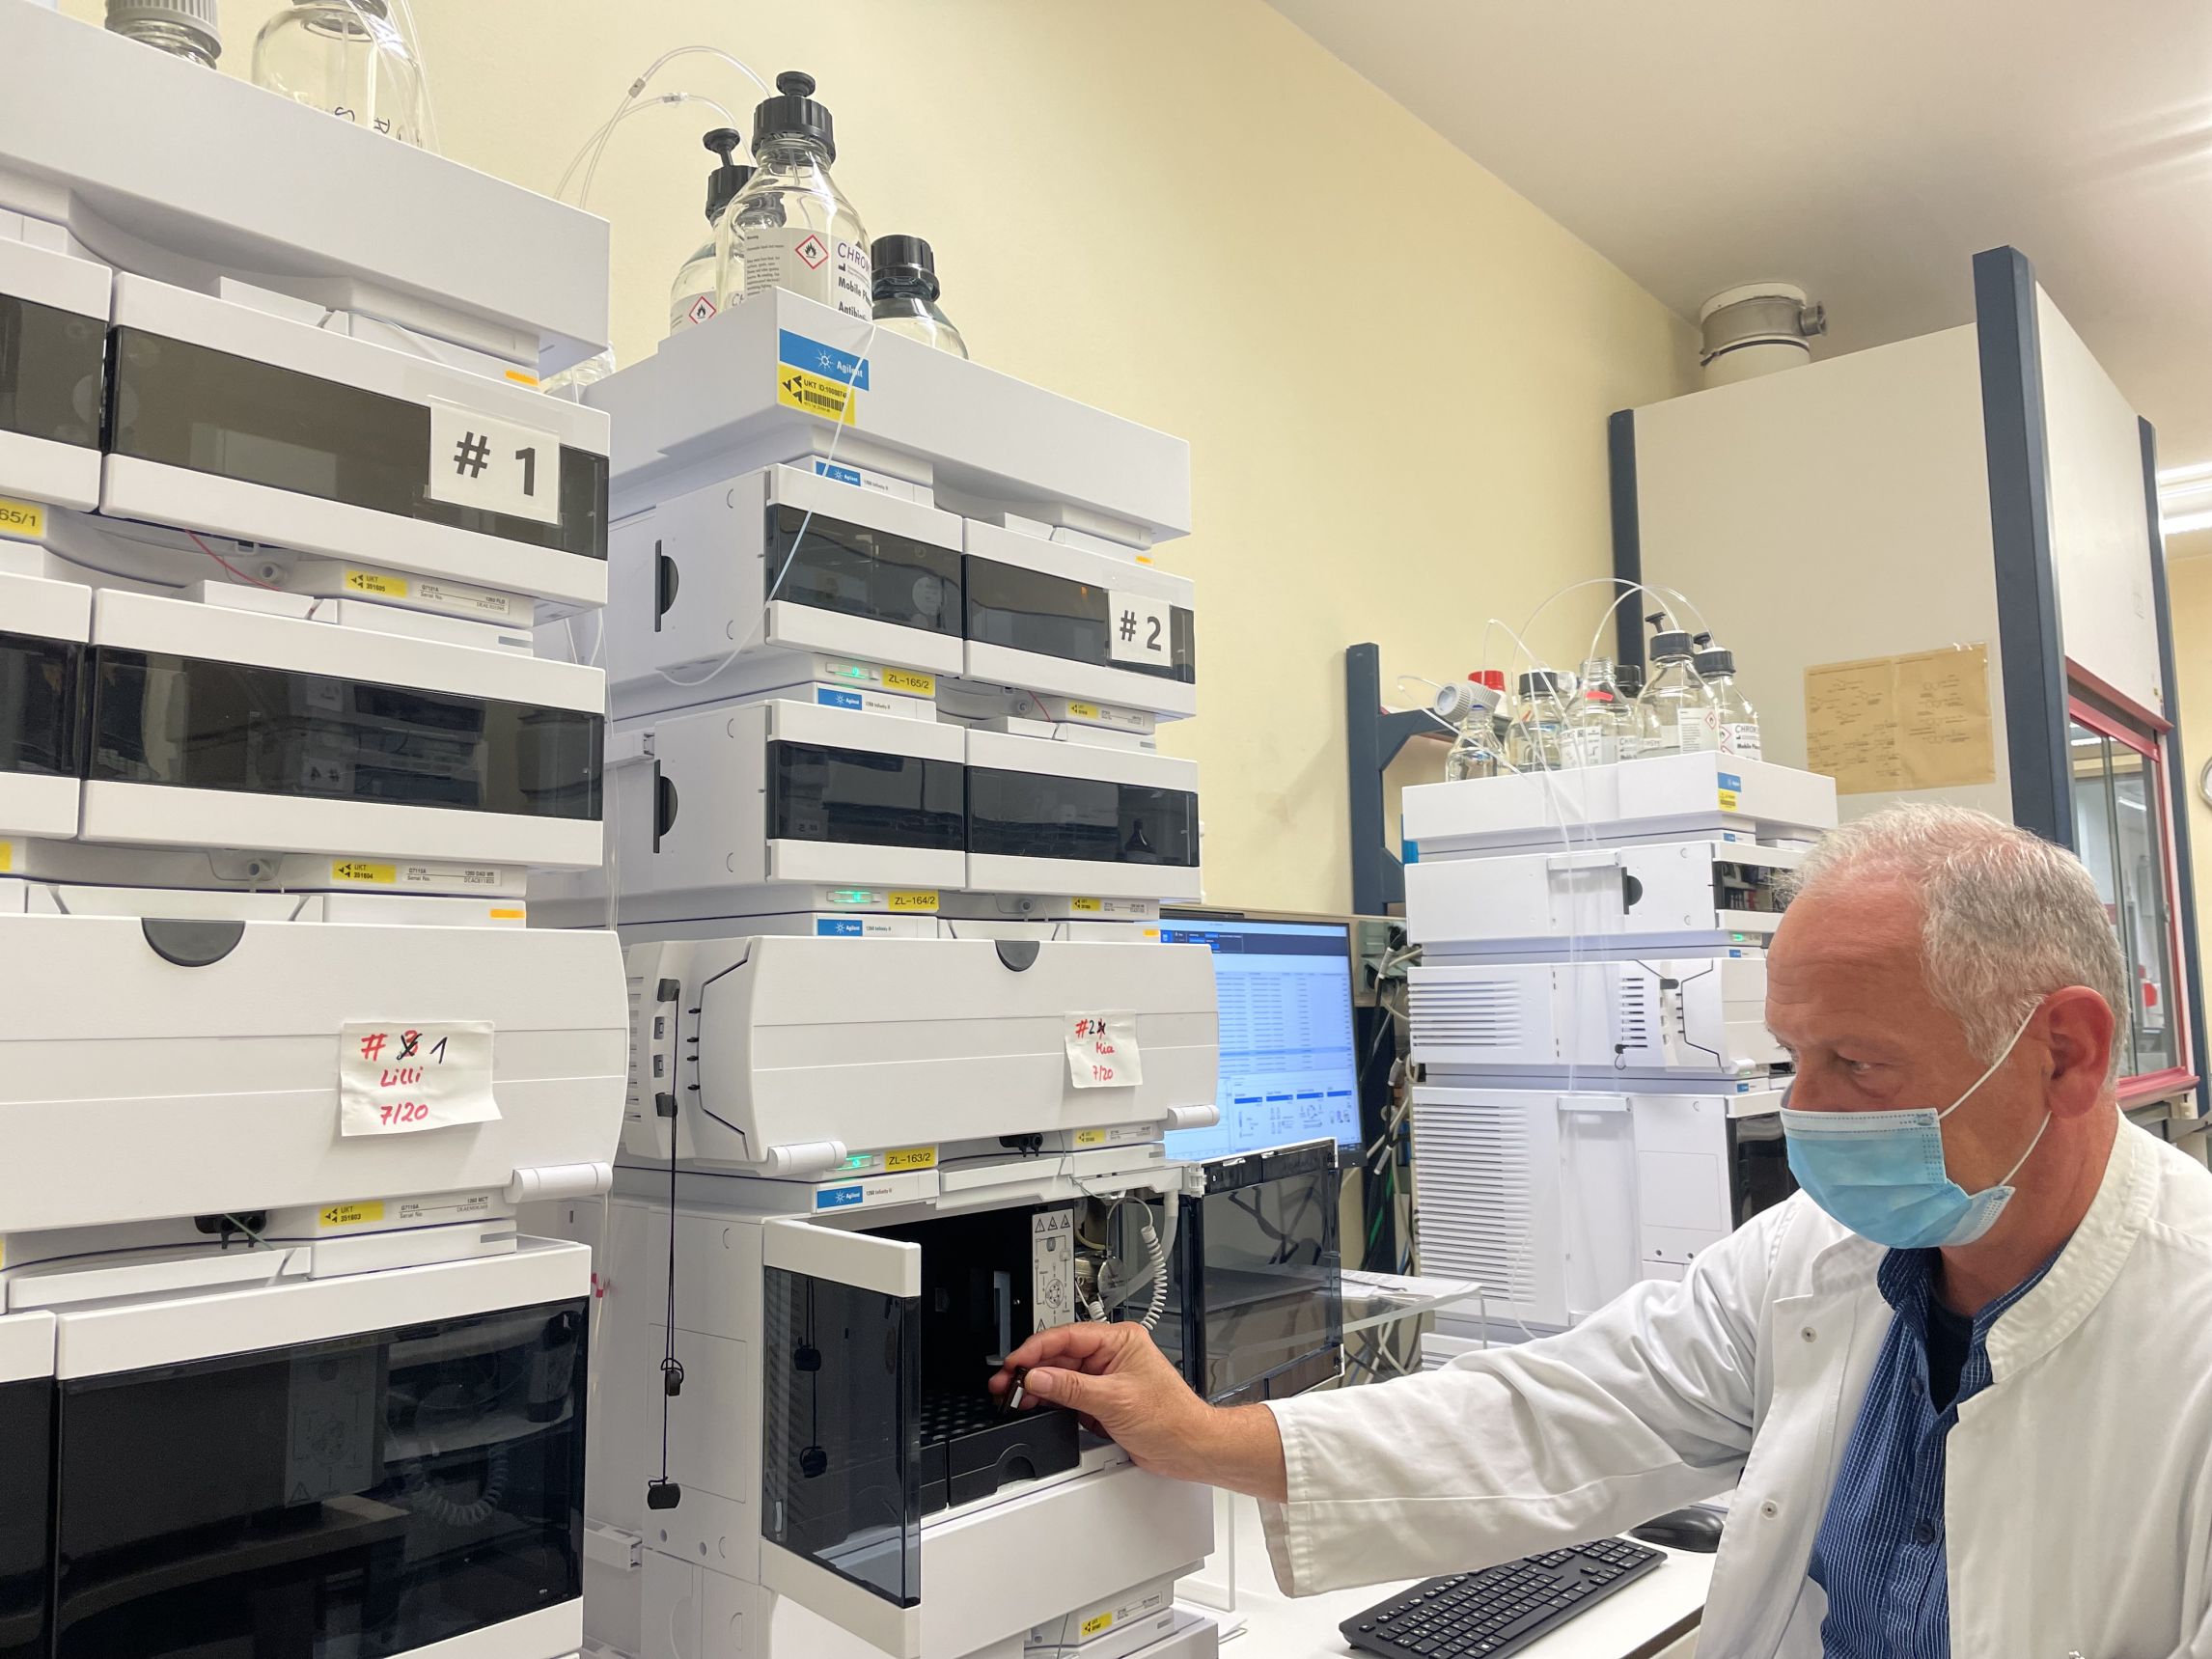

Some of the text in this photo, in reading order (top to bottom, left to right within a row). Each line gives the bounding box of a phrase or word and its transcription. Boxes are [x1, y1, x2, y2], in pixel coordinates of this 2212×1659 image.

[838, 276, 862, 296] Mobile
[837, 360, 863, 377] Agilnt
[803, 378, 817, 389] UKT
[454, 431, 536, 496] # 1
[1120, 610, 1162, 651] # 2
[888, 675, 929, 689] ZL-165/2
[895, 897, 935, 905] ZL-164/2
[361, 1033, 388, 1062] #
[380, 1065, 424, 1088] Lilli
[1092, 1065, 1114, 1081] 7/20
[380, 1102, 429, 1125] 7/20
[888, 1152, 931, 1166] ZL-163/2
